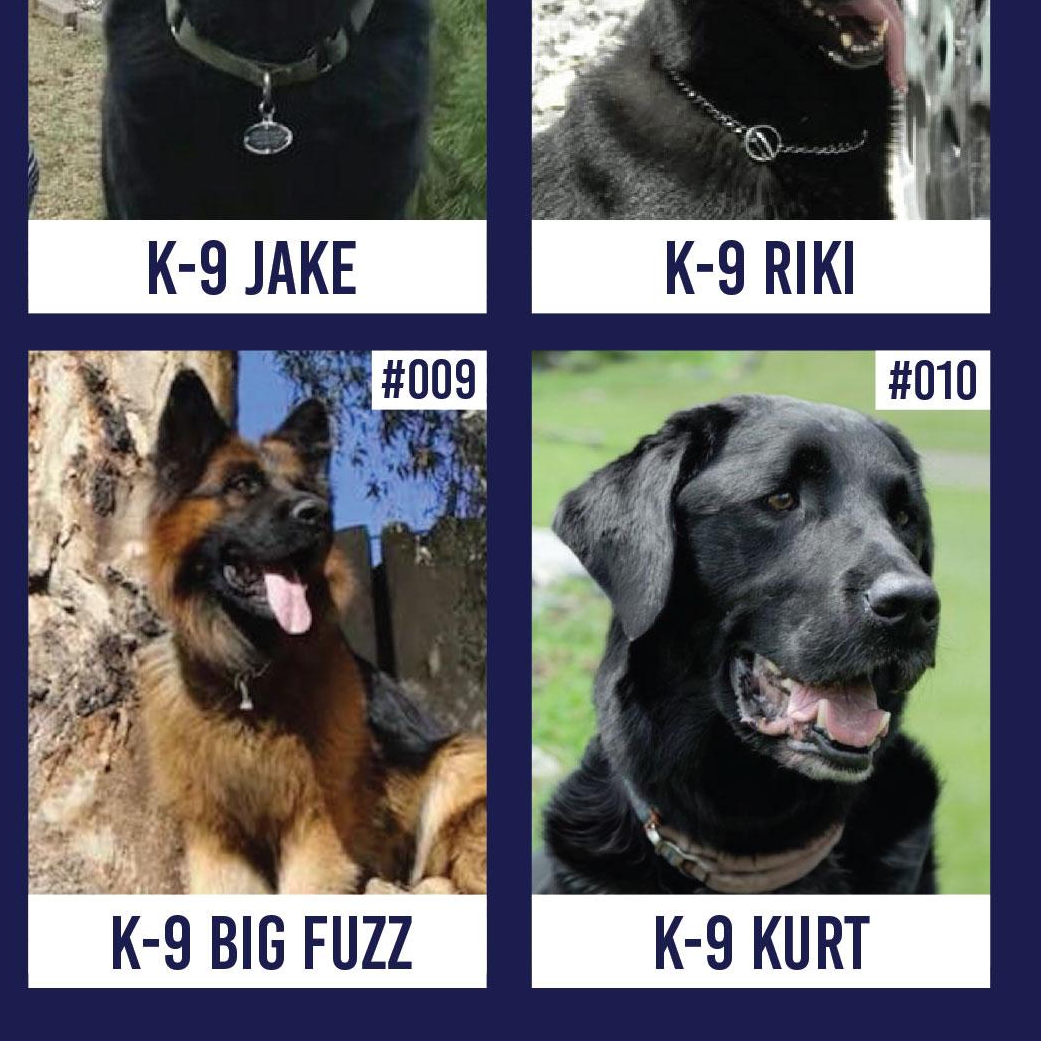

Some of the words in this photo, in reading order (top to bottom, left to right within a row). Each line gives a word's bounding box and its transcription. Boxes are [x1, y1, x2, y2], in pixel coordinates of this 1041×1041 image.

[149, 240, 226, 295] K-9
[245, 240, 356, 295] JAKE
[667, 240, 744, 295] K-9
[766, 240, 854, 295] RIKI
[382, 359, 475, 399] #009
[889, 360, 977, 400] #010
[113, 915, 190, 970] K-9
[212, 915, 284, 970] BIG
[305, 915, 412, 970] FUZZ
[656, 915, 732, 970] K-9
[754, 915, 870, 970] KURT
